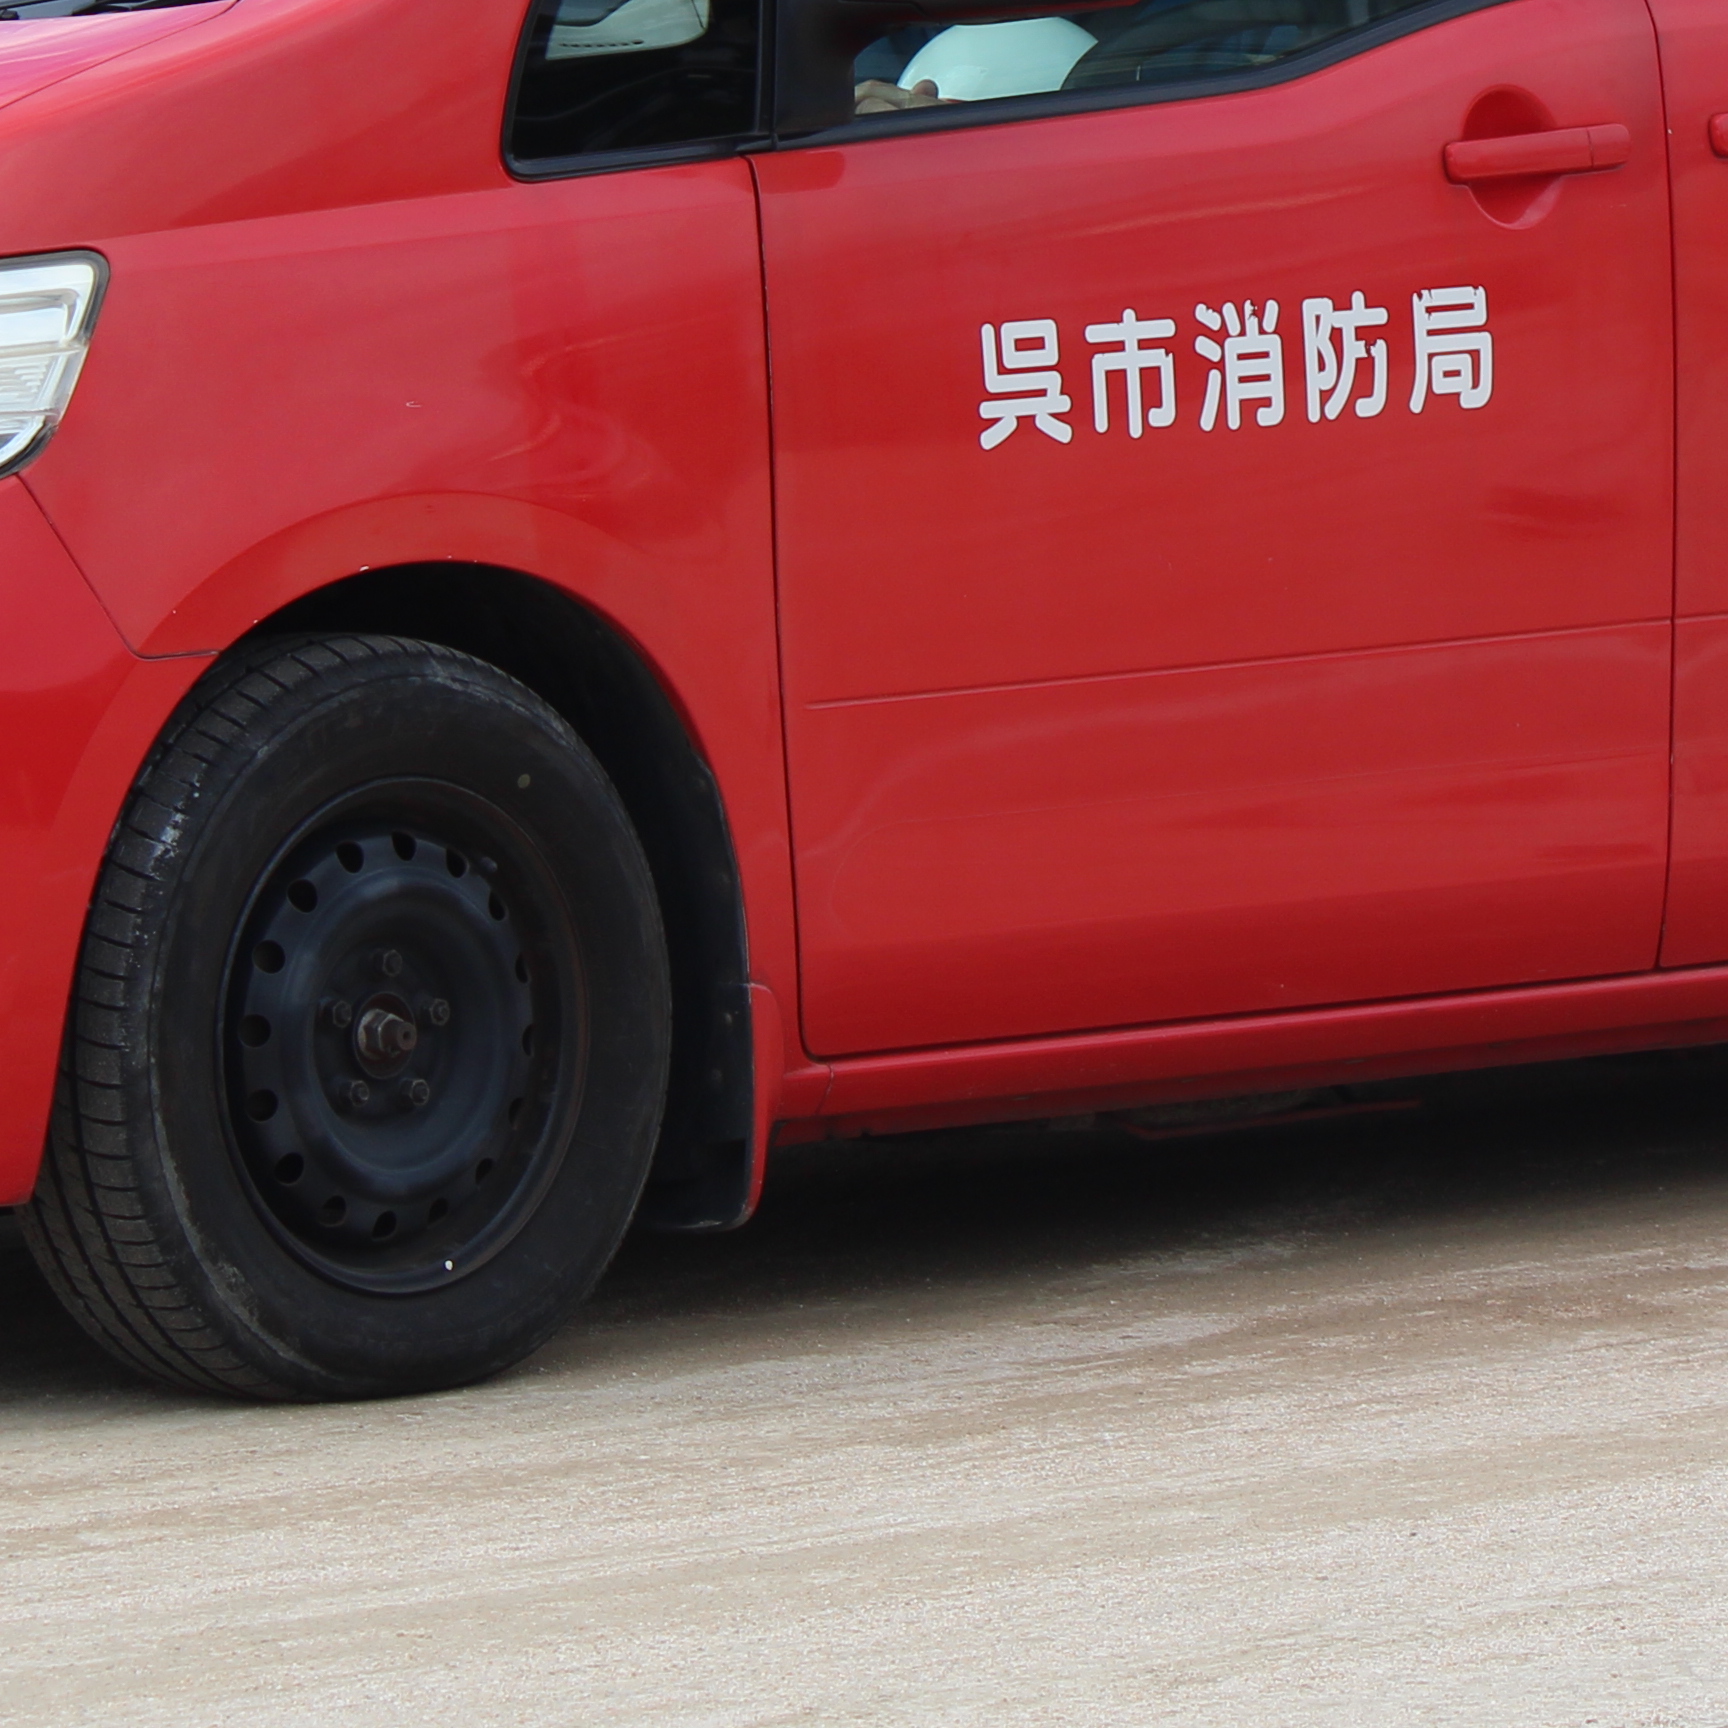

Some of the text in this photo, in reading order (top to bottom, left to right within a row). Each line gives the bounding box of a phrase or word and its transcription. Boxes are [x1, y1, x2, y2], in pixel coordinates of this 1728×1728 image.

[978, 284, 1495, 451] 呉市消防局
